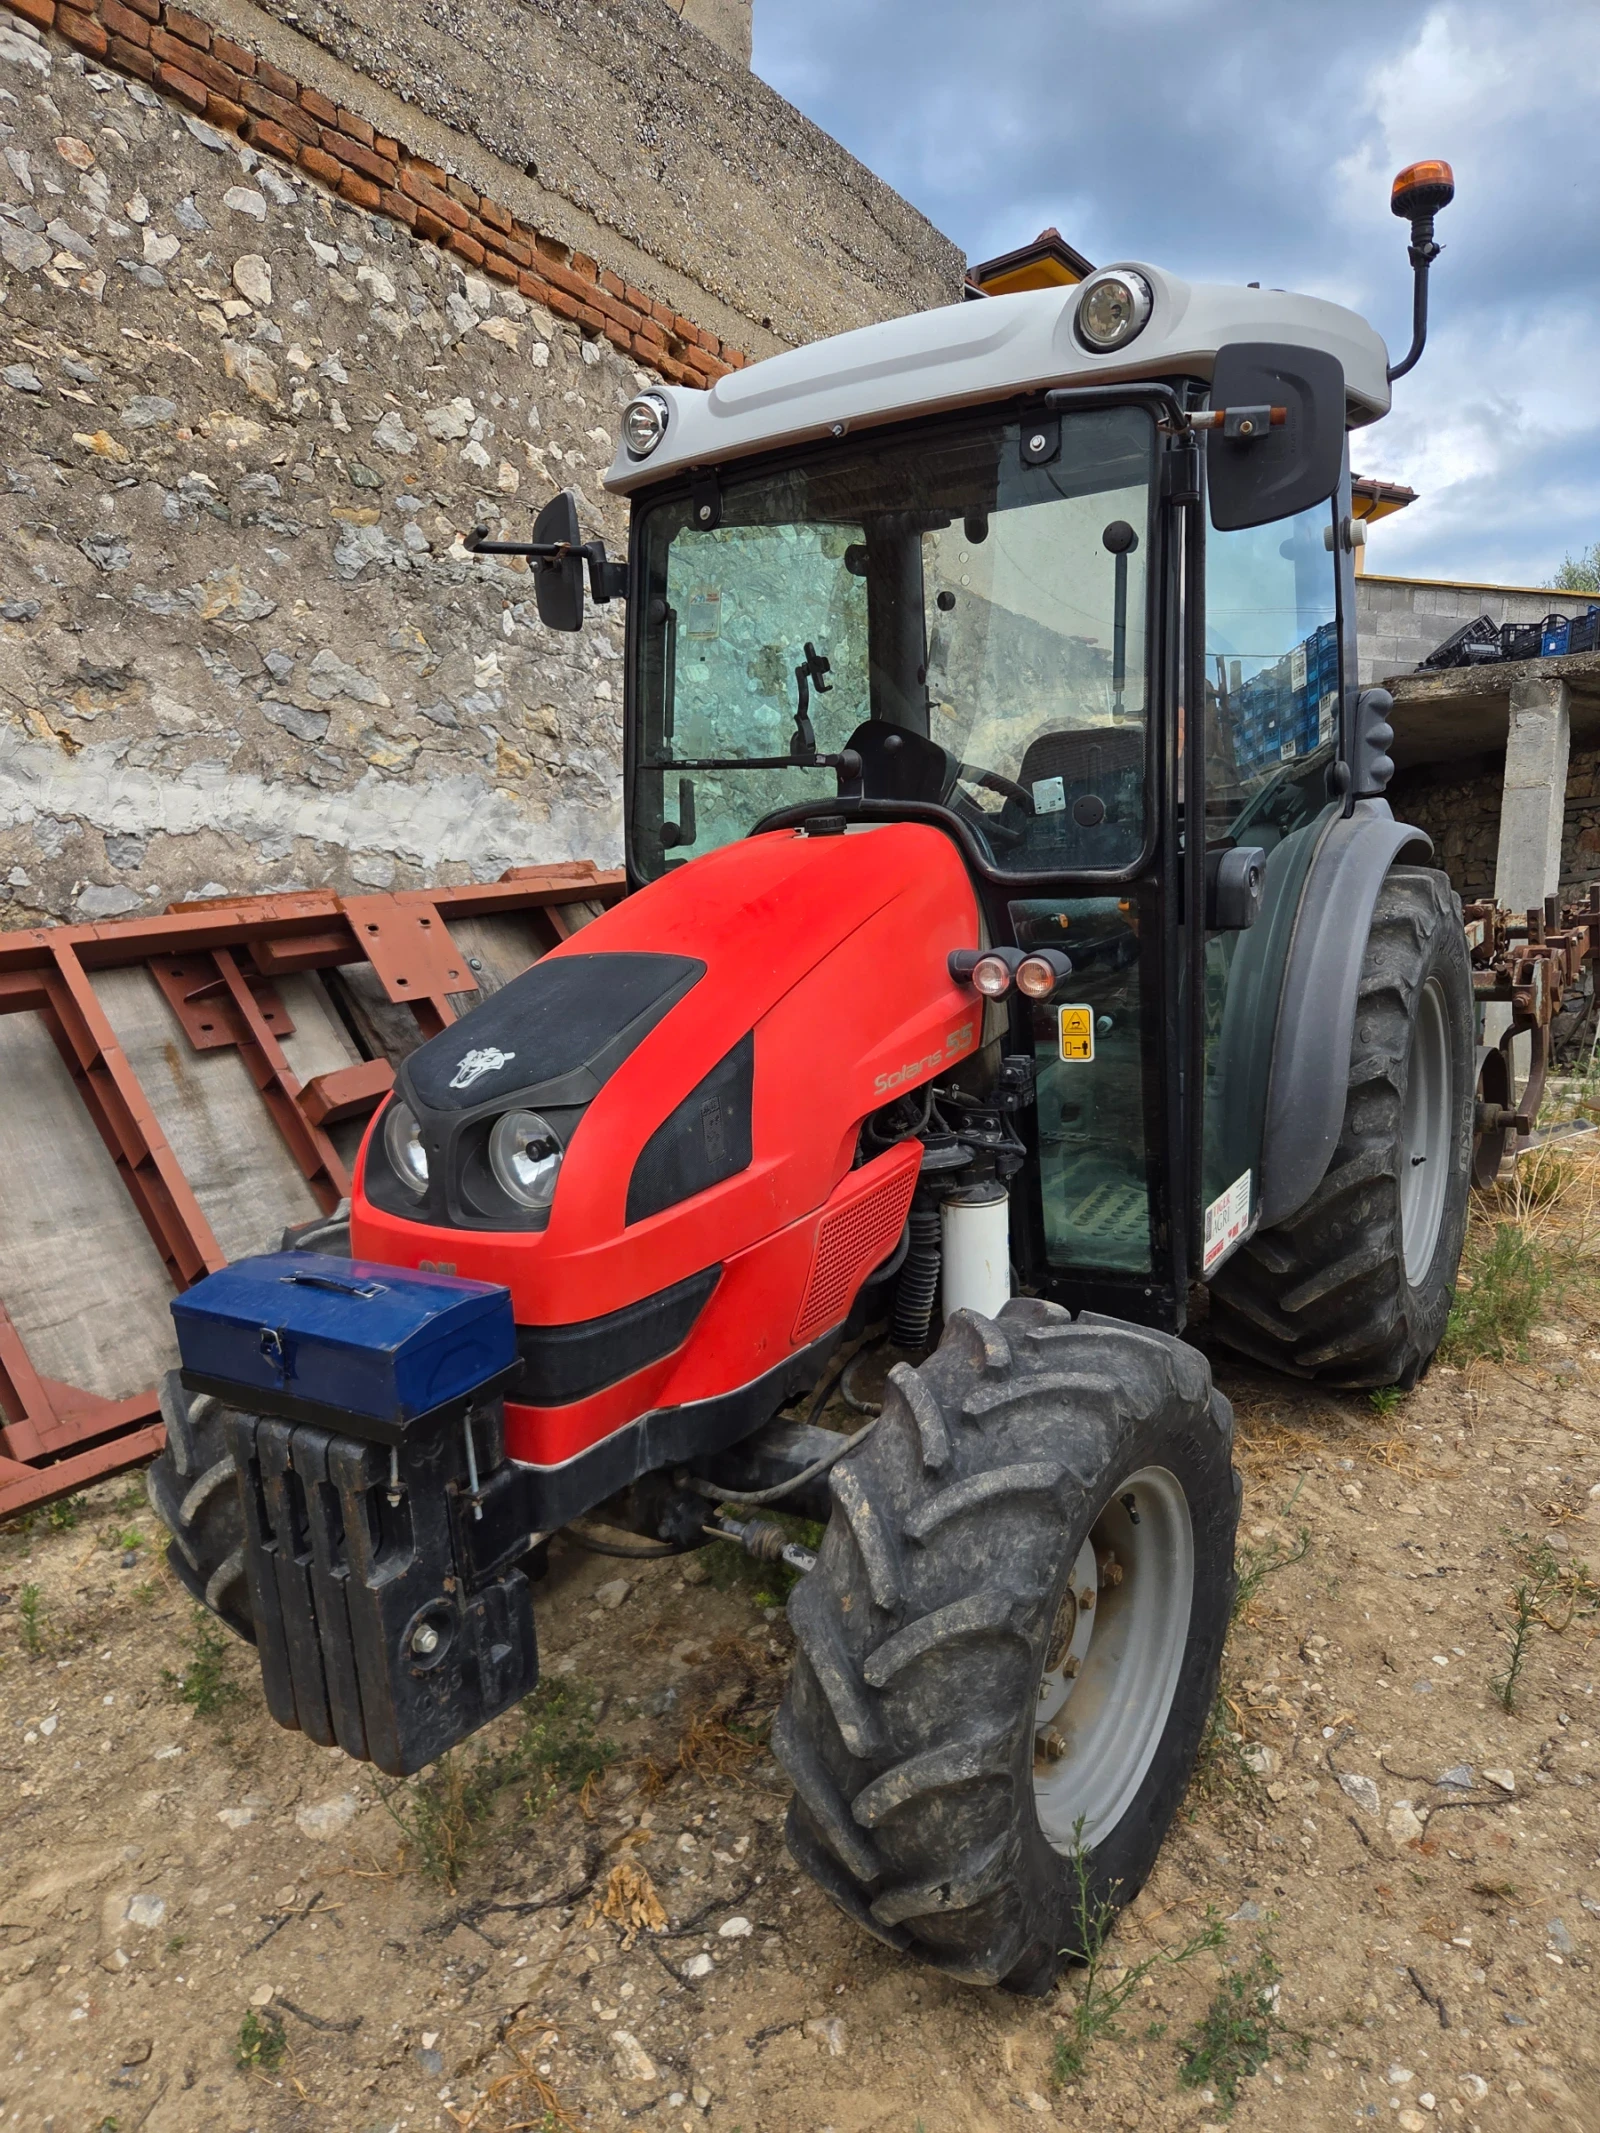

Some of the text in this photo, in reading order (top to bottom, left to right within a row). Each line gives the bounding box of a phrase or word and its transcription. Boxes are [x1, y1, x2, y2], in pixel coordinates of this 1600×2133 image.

[874, 1021, 973, 1095] Solaris 55
[1460, 1095, 1474, 1172] BKT
[1213, 1206, 1230, 1234] AGRI
